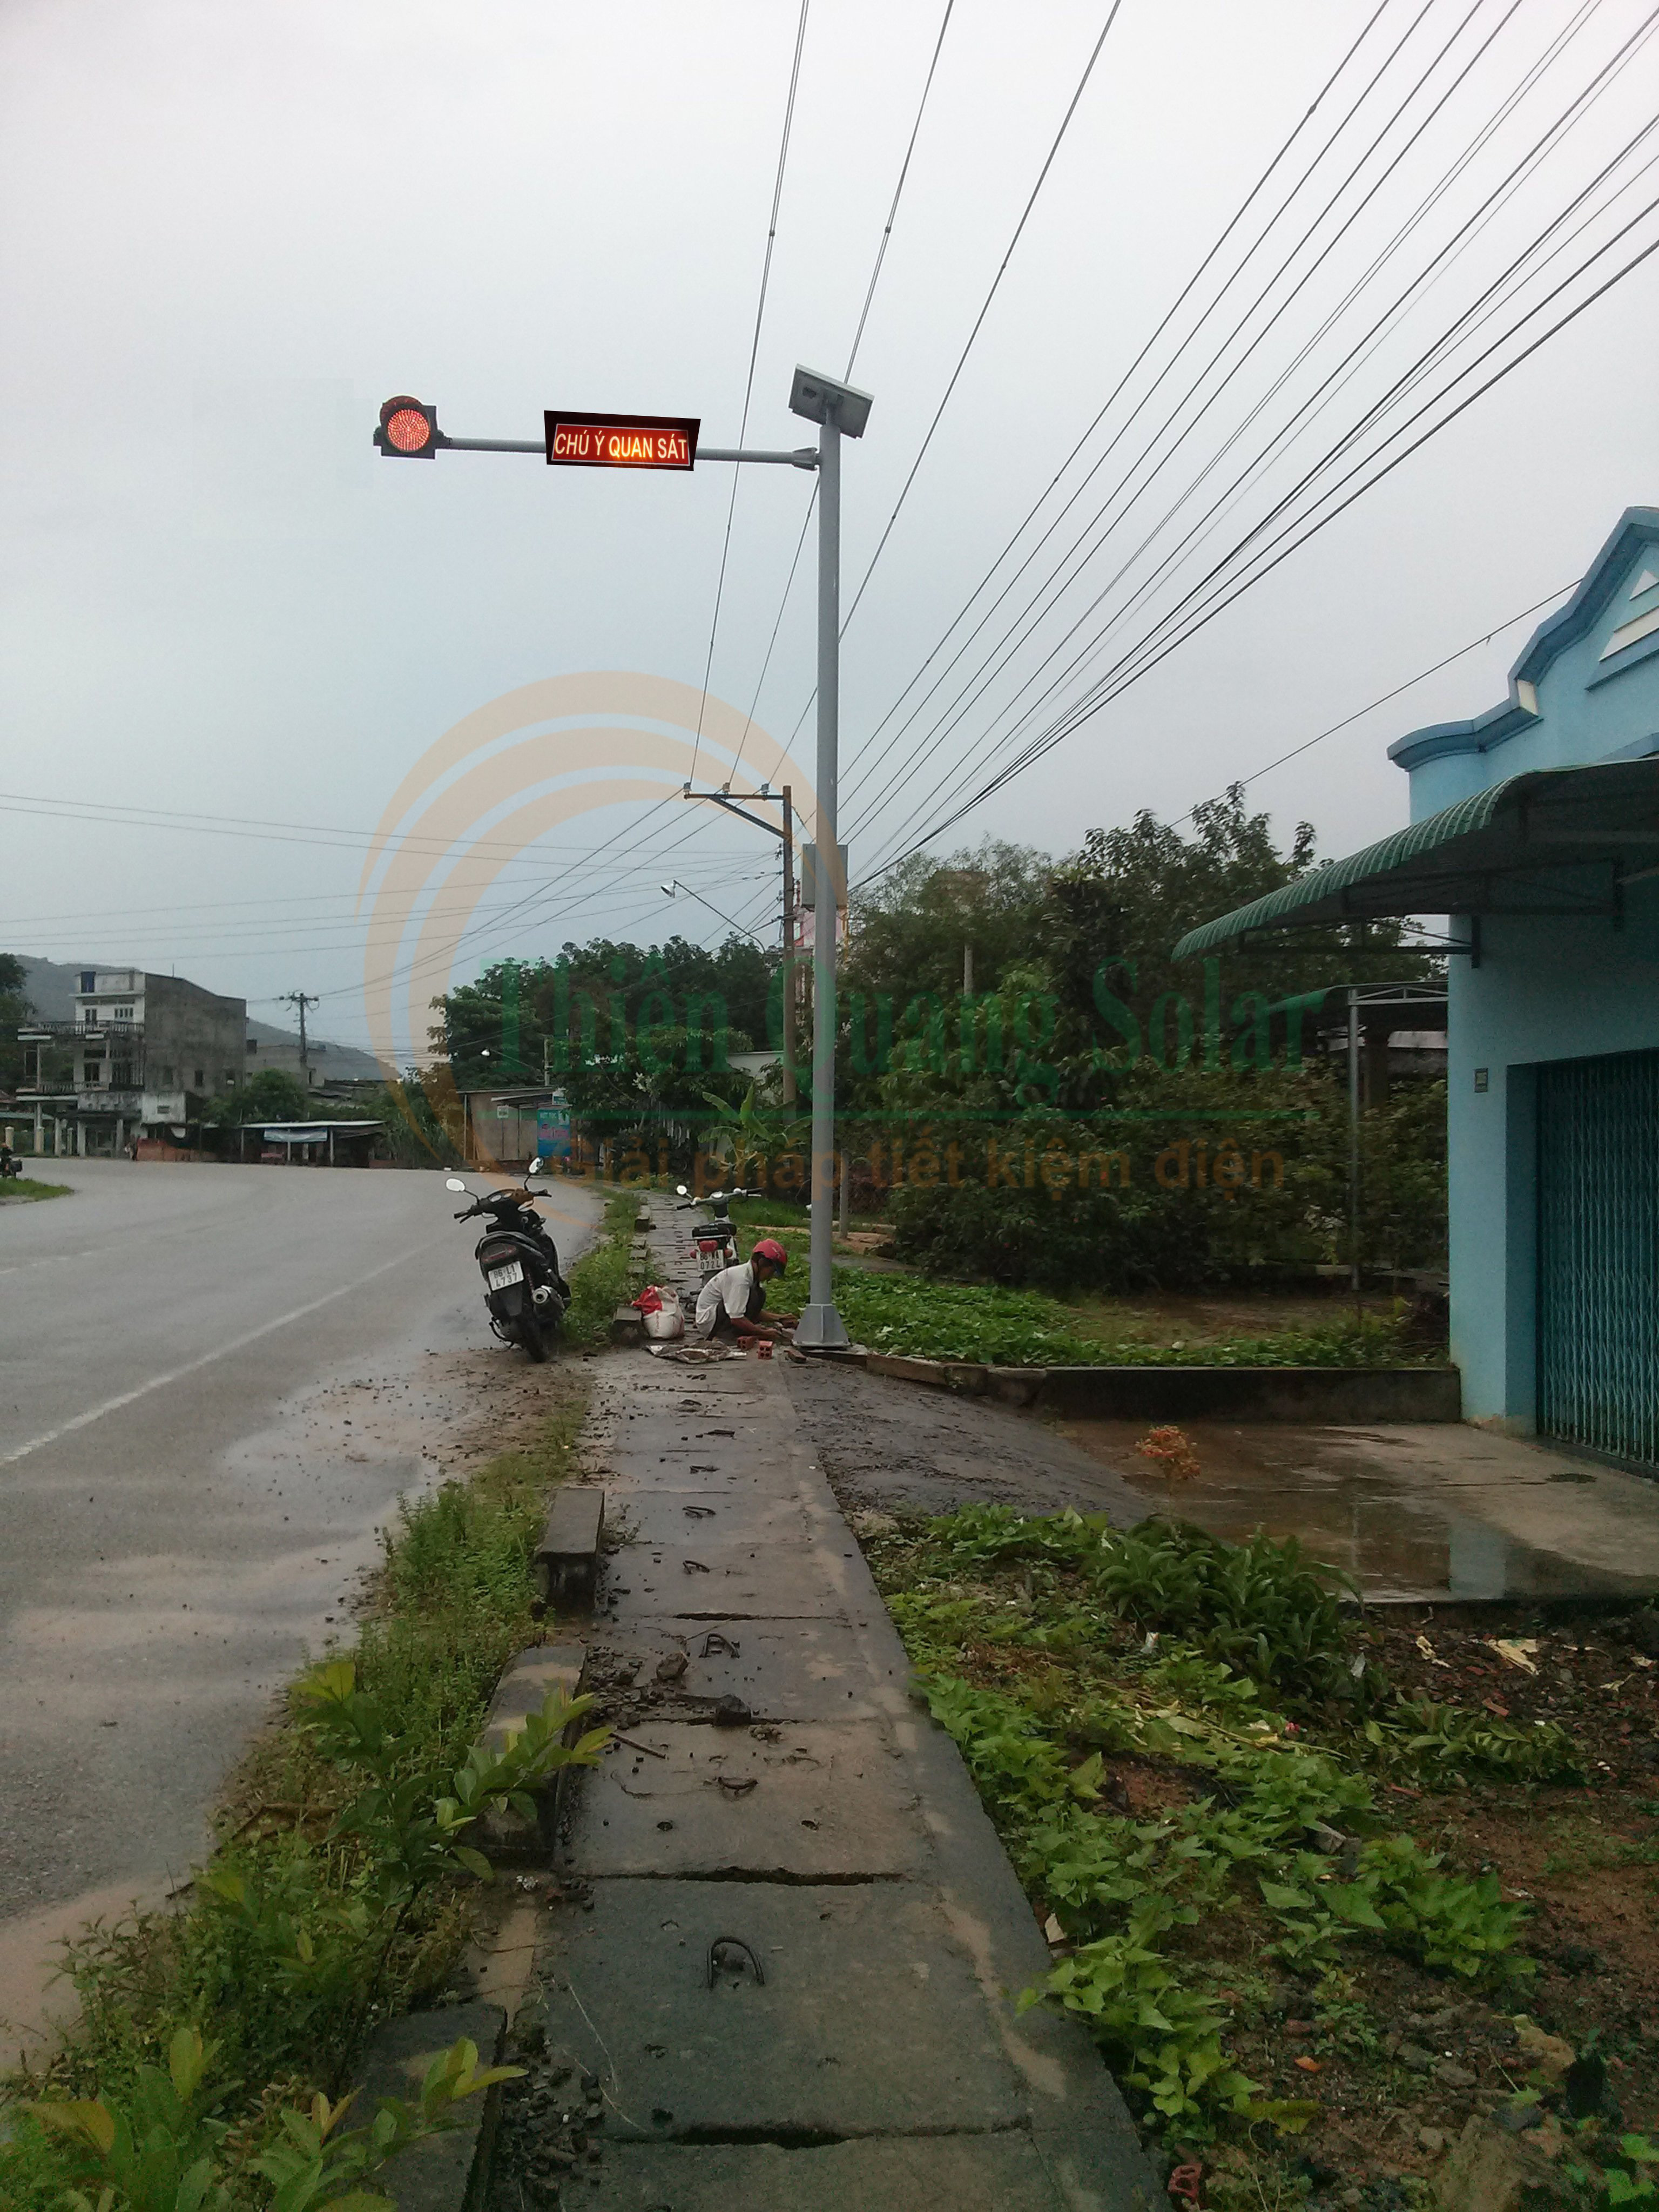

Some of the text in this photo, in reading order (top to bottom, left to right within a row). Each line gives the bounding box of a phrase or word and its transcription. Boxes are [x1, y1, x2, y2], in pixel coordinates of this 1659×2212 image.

[555, 429, 687, 459] CHÚ Ý QUAN SÁT
